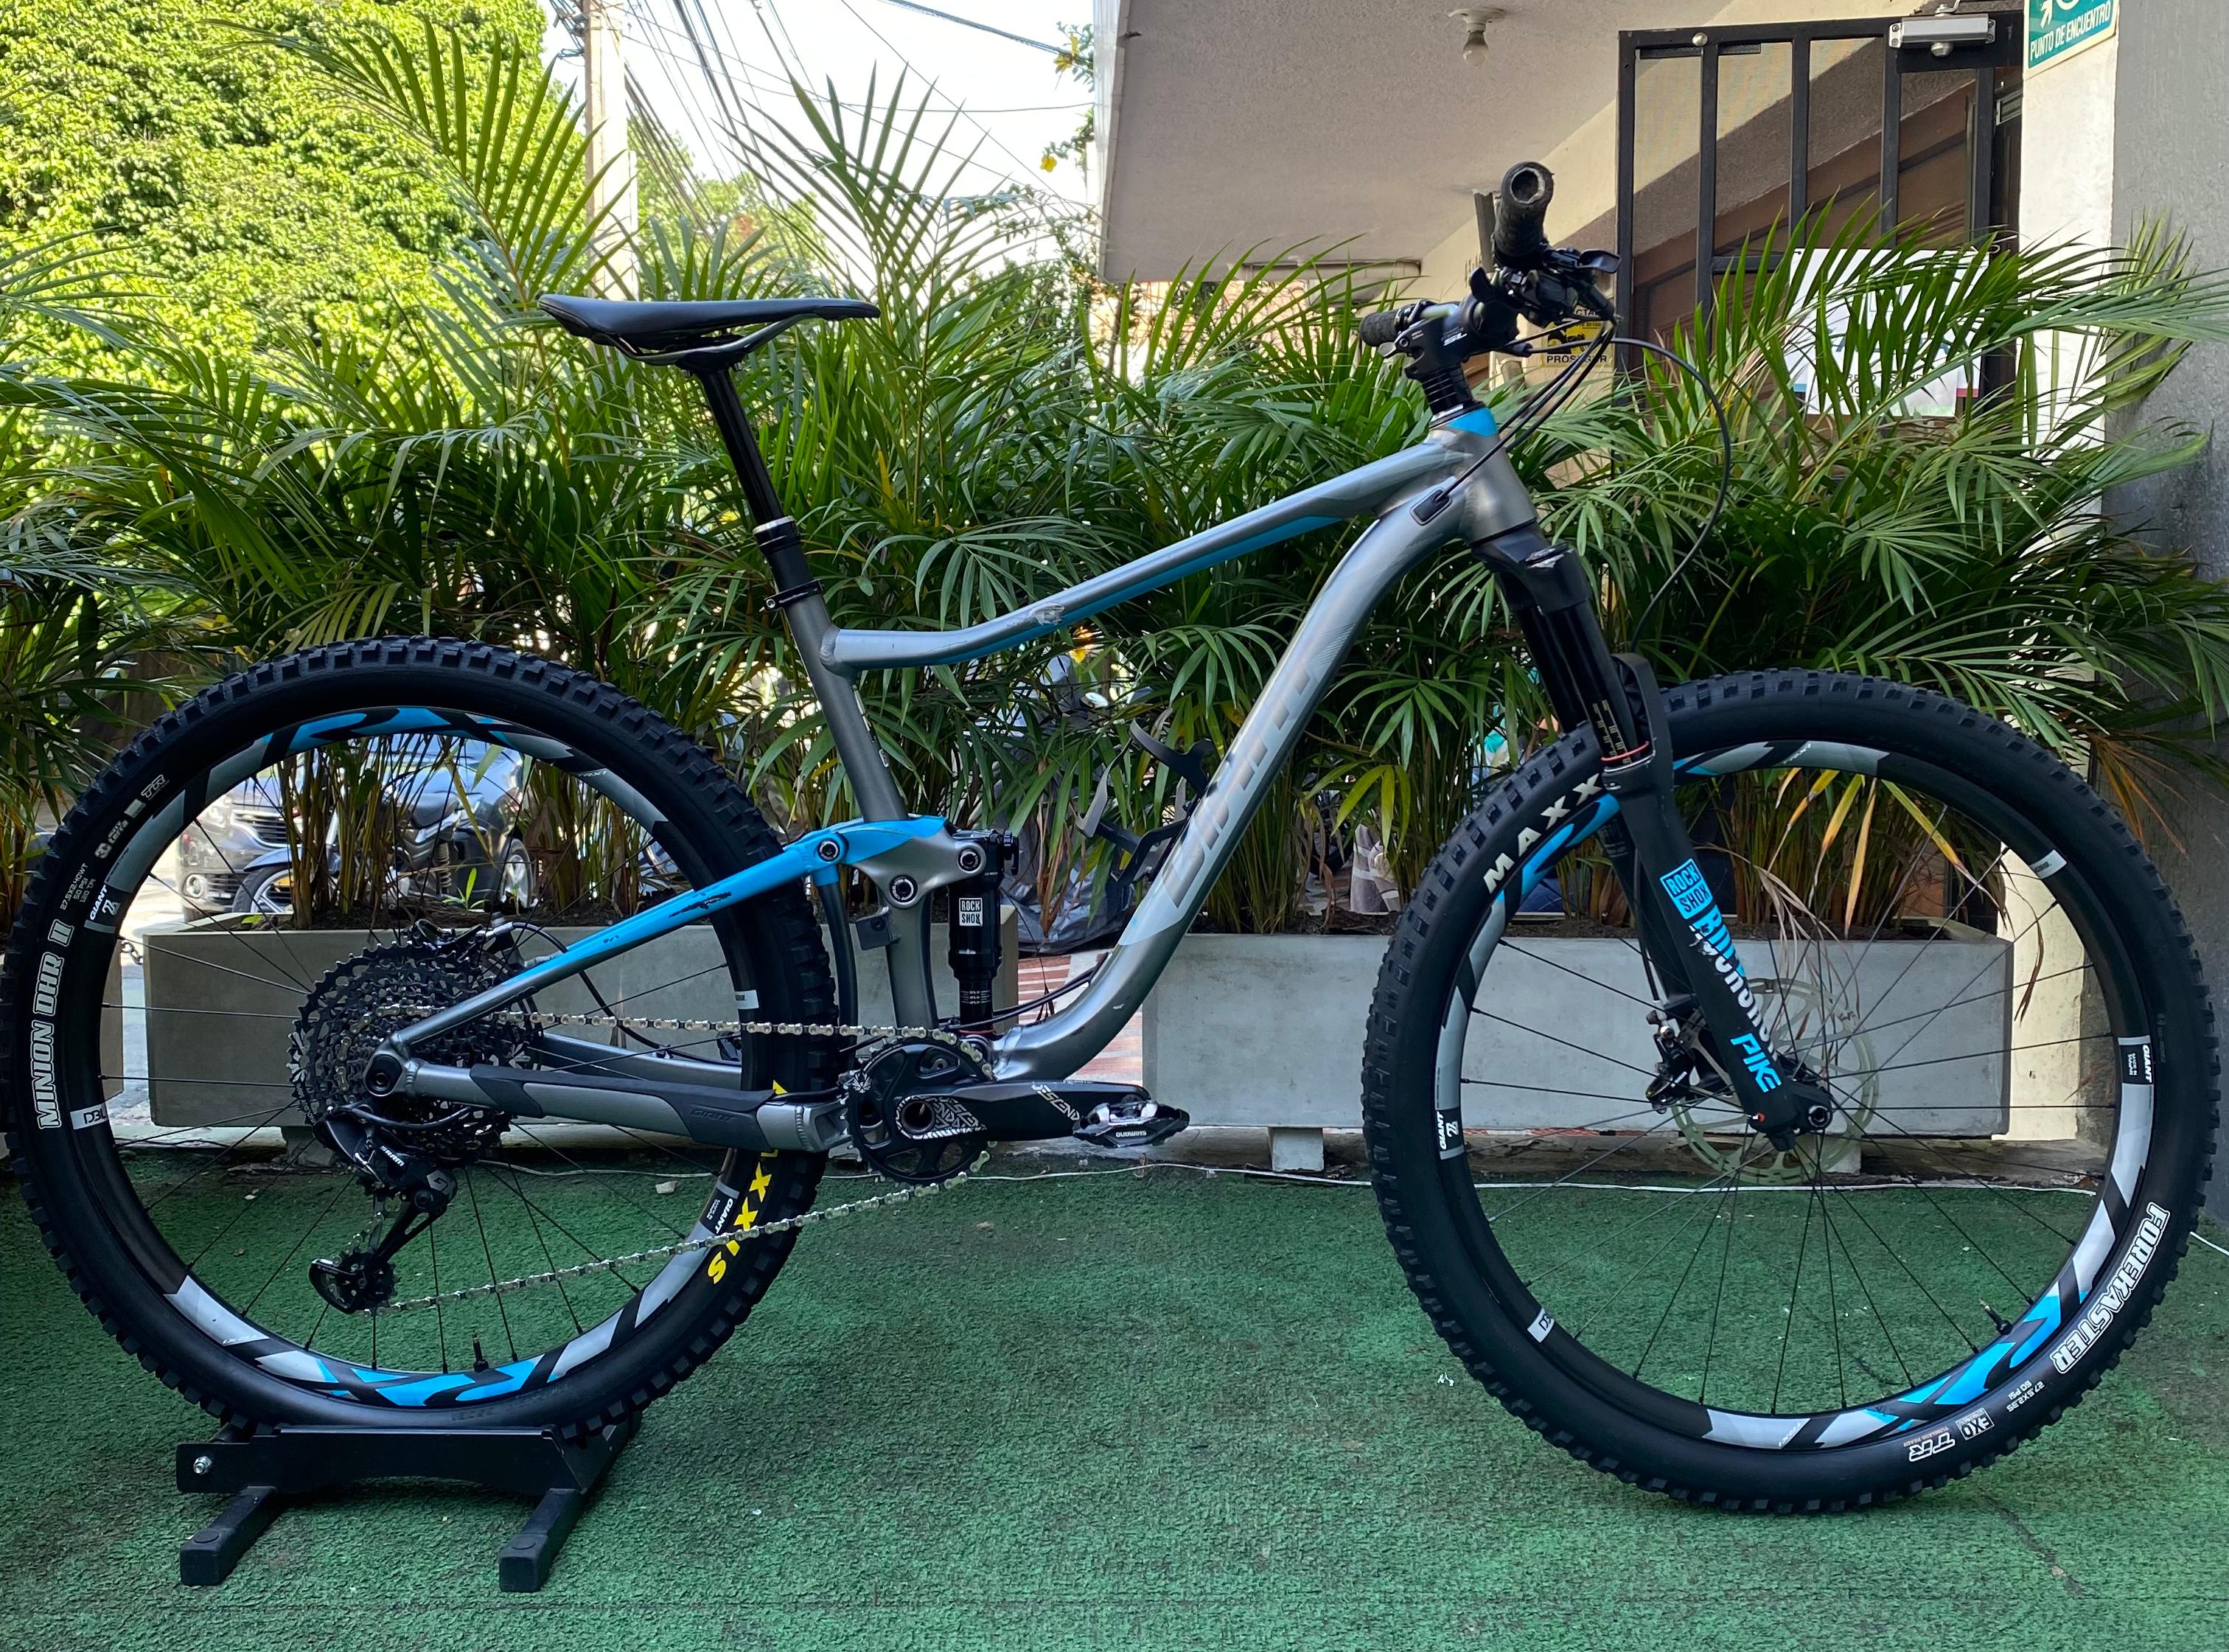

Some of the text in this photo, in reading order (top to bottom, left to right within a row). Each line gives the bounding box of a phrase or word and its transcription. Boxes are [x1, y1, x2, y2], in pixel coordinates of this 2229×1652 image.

[2030, 1, 2112, 61] PUNTO DE ENCUENTRO
[141, 774, 166, 798] TR
[1665, 864, 1700, 896] ROCK
[90, 884, 108, 921] GIANT
[960, 900, 980, 912] ROCK
[1679, 883, 1711, 913] SHOX
[961, 913, 982, 925] SHOX
[30, 919, 74, 1130] MINION DHR II
[1731, 1033, 1782, 1093] PIKE
[2143, 1045, 2152, 1083] GIANT
[1437, 1110, 1447, 1150] GIANT
[380, 1146, 405, 1167] SRAM
[715, 1198, 733, 1234] GIANT
[2049, 1202, 2171, 1374] FOREKASTER
[2008, 1380, 2032, 1400] 60 PSI
[1961, 1415, 1990, 1438] EXO
[1909, 1432, 1956, 1463] TR
